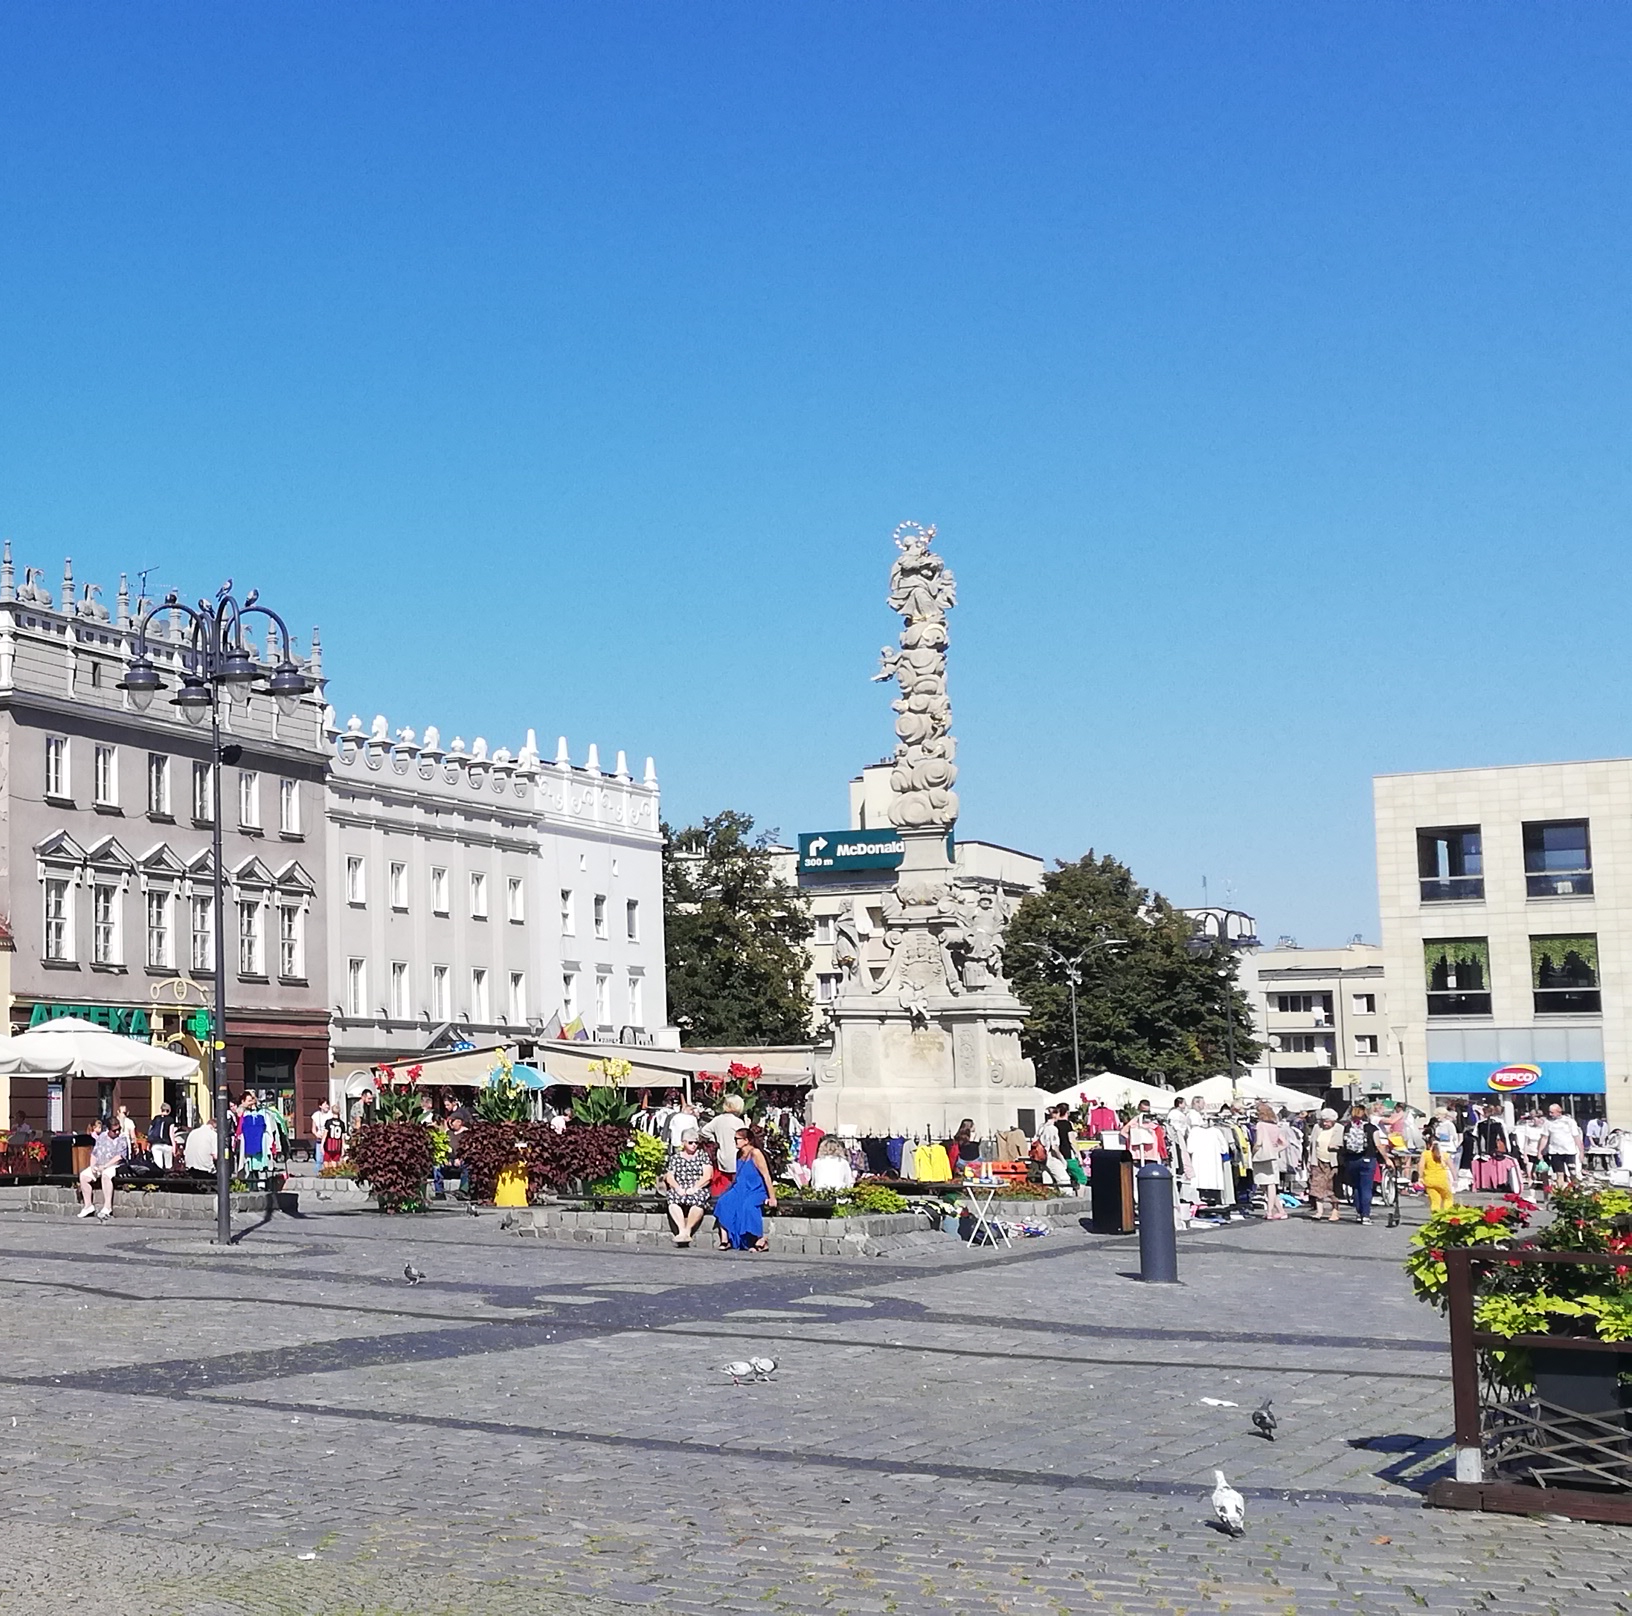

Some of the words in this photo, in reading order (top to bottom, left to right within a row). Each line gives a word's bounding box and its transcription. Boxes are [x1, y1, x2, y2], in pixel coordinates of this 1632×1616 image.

[804, 858, 823, 867] 300
[823, 858, 834, 866] m
[29, 1003, 150, 1035] APTEKA
[1495, 1072, 1533, 1082] PEPCO
